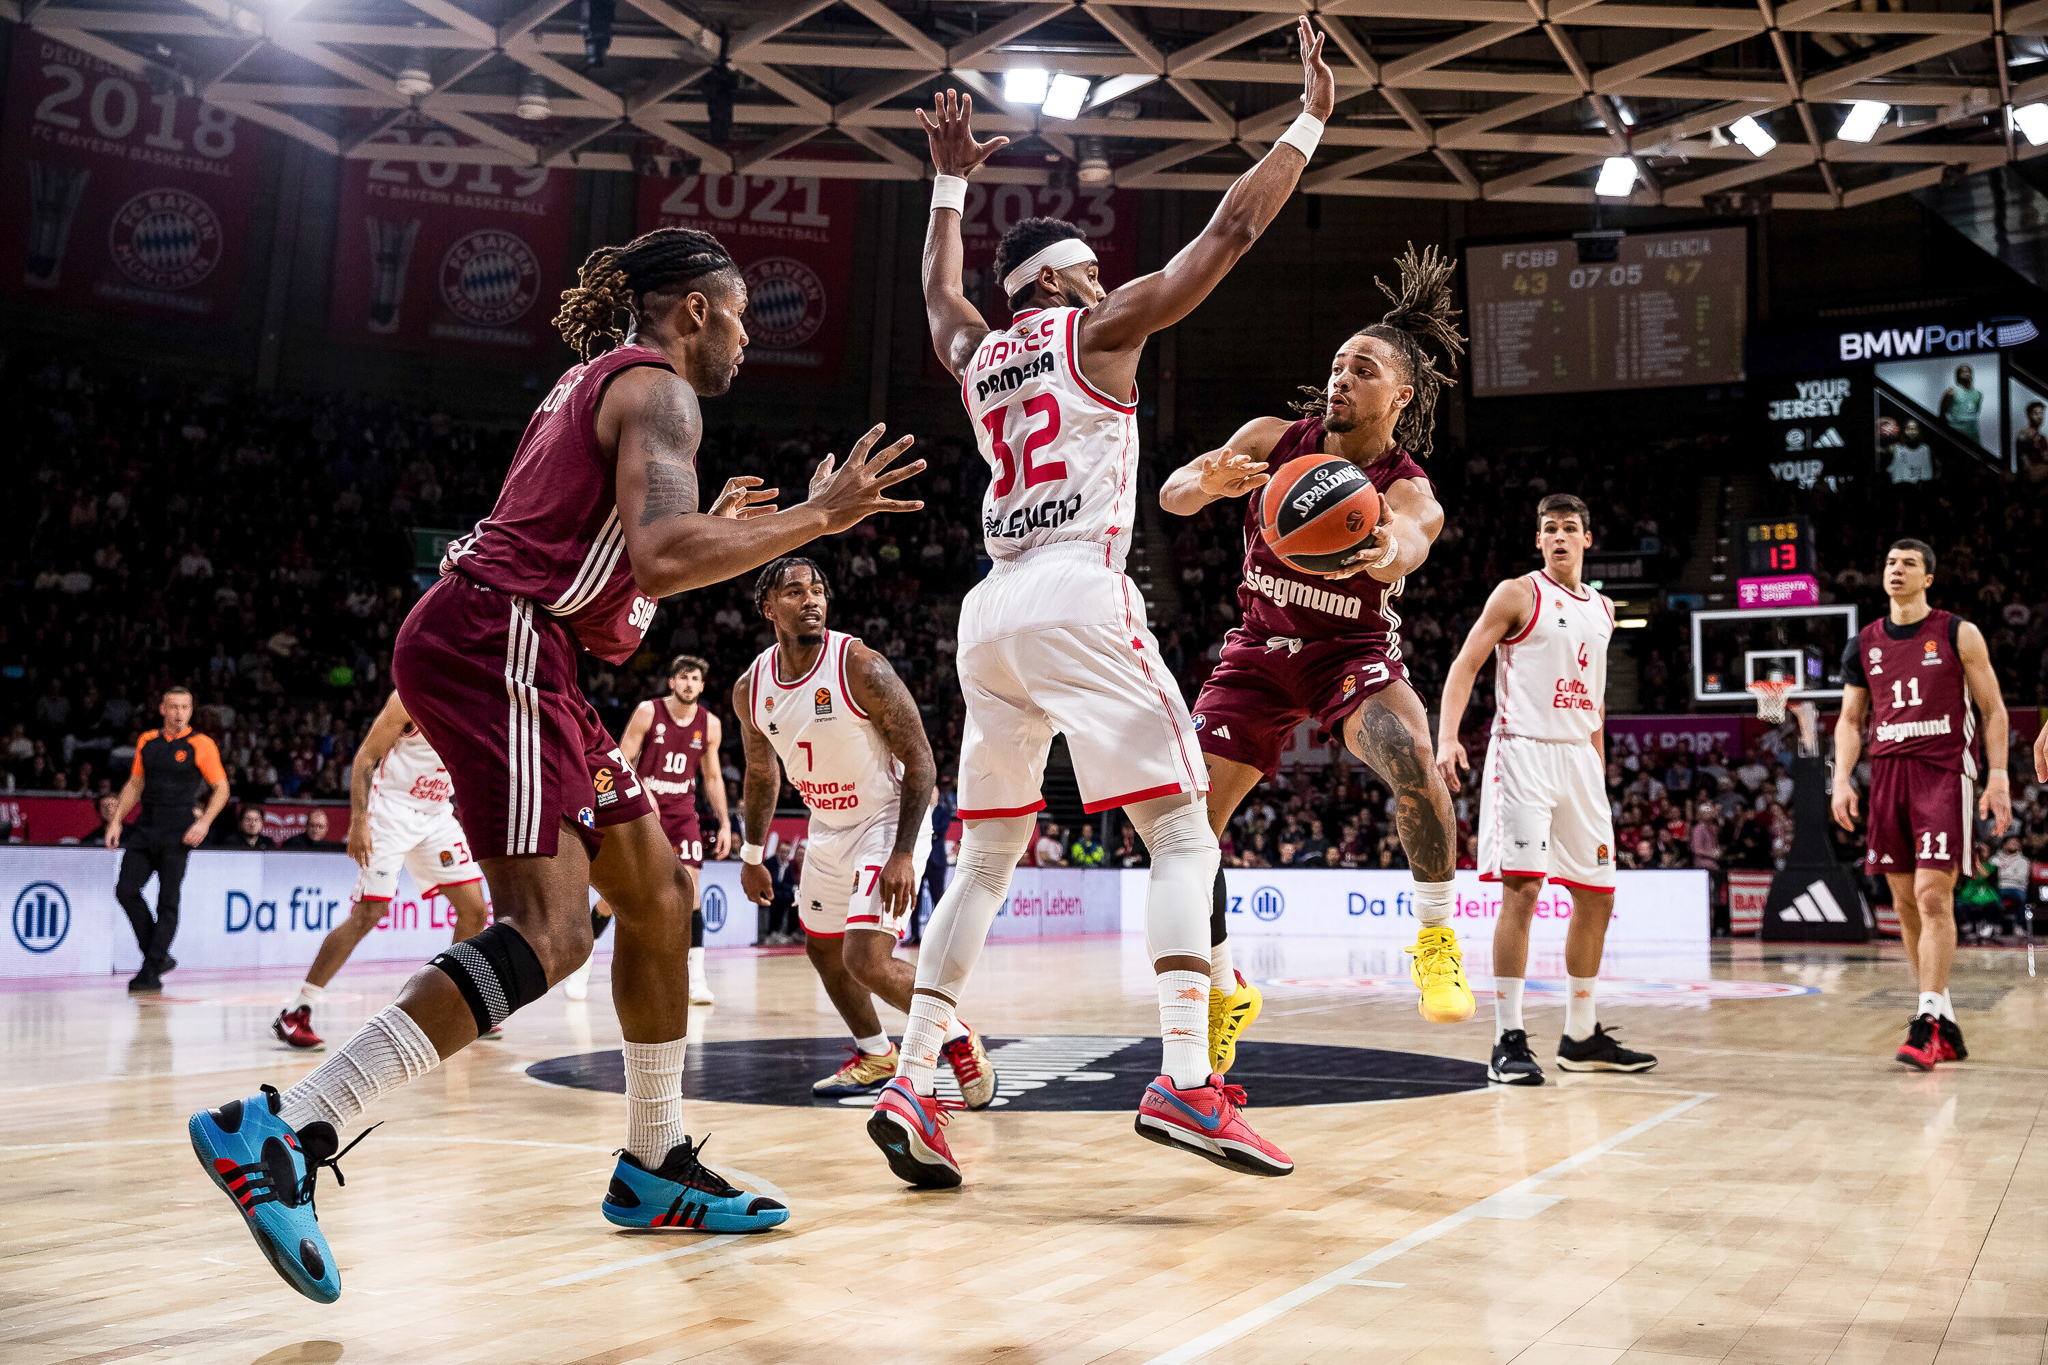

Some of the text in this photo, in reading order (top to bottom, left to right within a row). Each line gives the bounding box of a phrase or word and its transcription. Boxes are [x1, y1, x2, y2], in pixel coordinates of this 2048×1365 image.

[35, 64, 236, 158] 2018
[31, 123, 231, 177] FC BAYERN BASKETBALL
[366, 182, 546, 216] FC BAYERN BASKETBALL
[660, 174, 831, 229] 2021
[962, 184, 1116, 237] 2023
[739, 221, 830, 243] BASKETBALL
[1501, 238, 1713, 270] FCBB VALENCIA
[1513, 272, 1548, 295] 43
[1665, 261, 1703, 284] 47
[1795, 377, 1852, 400] YOUR
[1768, 398, 1844, 421] JERSEY
[981, 392, 1068, 503] 32
[1768, 459, 1825, 482] YOUR
[1292, 465, 1366, 518] SPALDING
[1770, 544, 1797, 570] 13
[1246, 566, 1362, 619] siegmund
[1760, 580, 1808, 593] MAGENTA
[1760, 591, 1793, 602] SPORT
[1578, 642, 1588, 671] 4
[1362, 662, 1389, 687] 3
[1891, 677, 1923, 709] 11
[1876, 714, 1952, 743] siegmund
[662, 751, 688, 775] 10
[797, 741, 813, 772] 7
[643, 775, 691, 795] siegmund
[841, 781, 855, 792] del
[453, 842, 470, 865] 3
[680, 839, 703, 862] 10
[1919, 831, 1951, 861] 11
[865, 865, 883, 896] 7
[227, 890, 276, 932] Da
[289, 887, 339, 931] für
[1012, 889, 1042, 916] dein
[1348, 892, 1386, 916] Da
